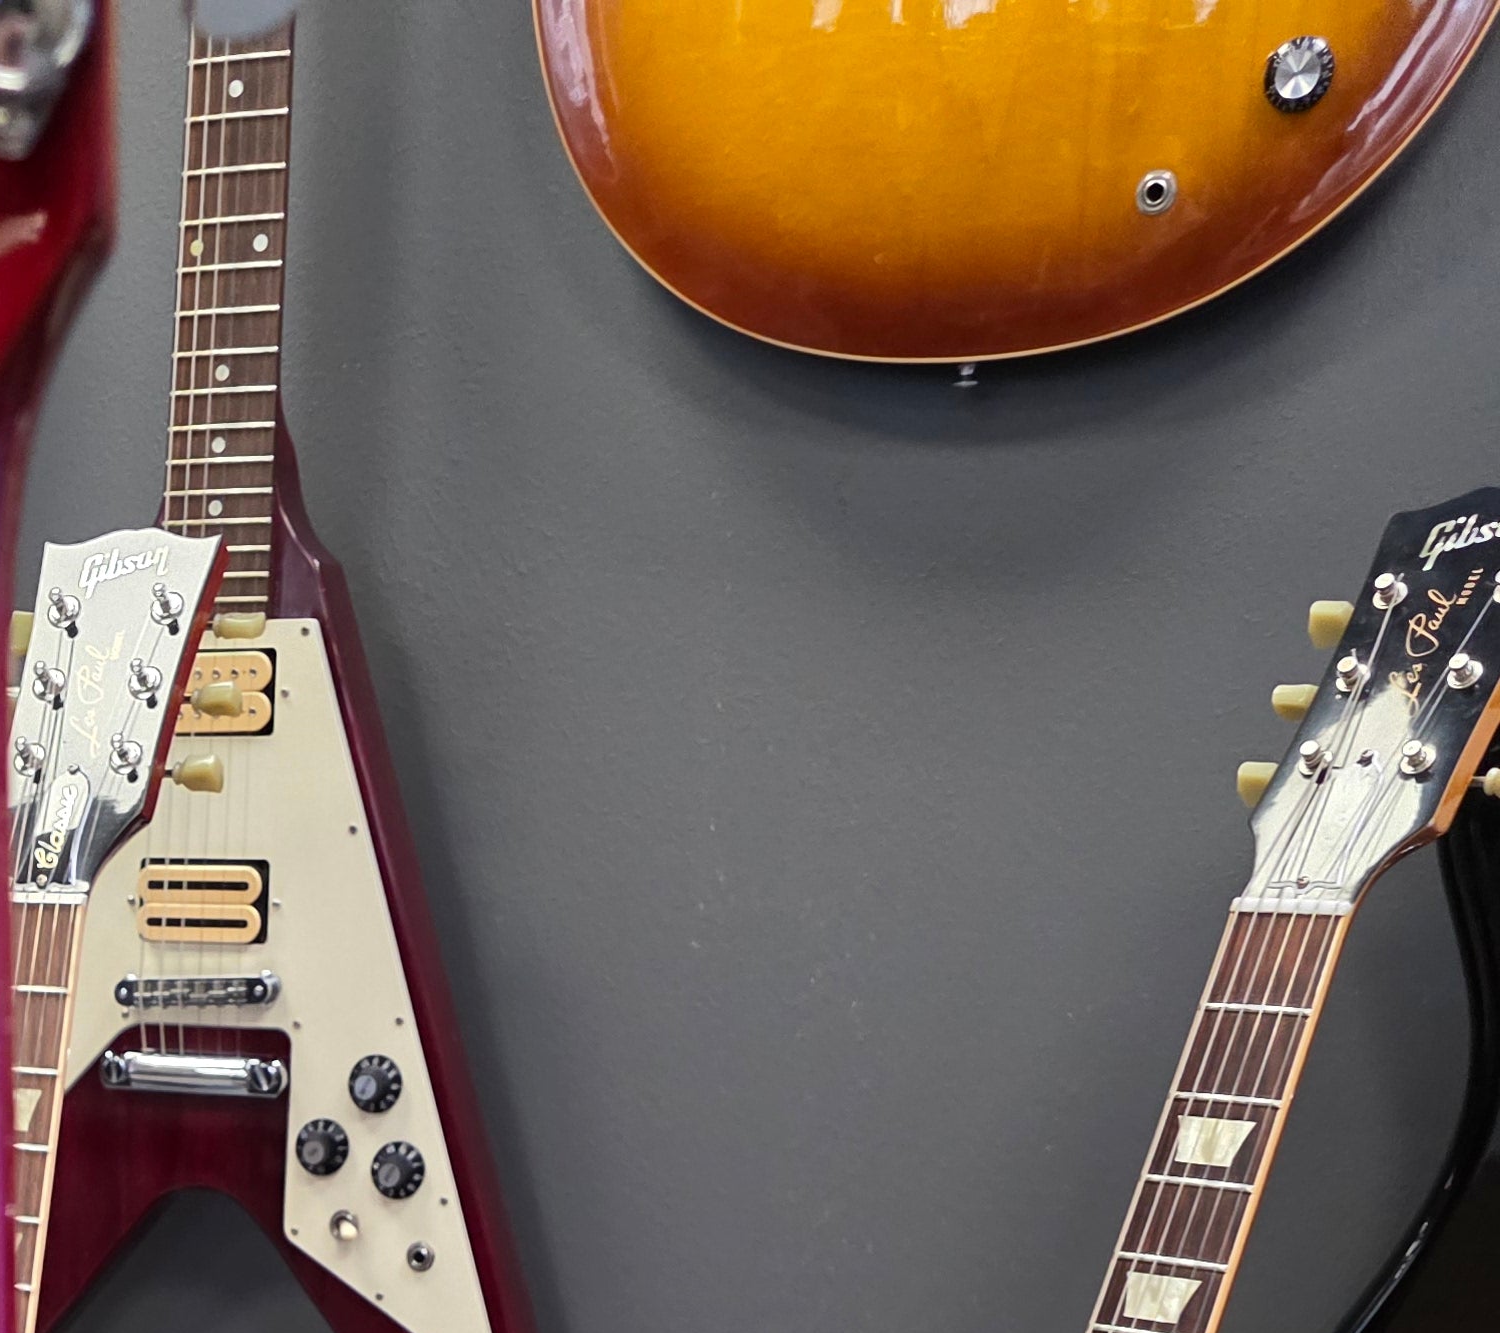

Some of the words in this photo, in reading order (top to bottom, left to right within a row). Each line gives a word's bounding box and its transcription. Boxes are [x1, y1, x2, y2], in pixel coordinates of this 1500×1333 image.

[78, 544, 169, 600] Gibson
[1418, 513, 1500, 571] Gibs
[1405, 588, 1457, 658] Paul
[77, 641, 114, 703] Paul
[1388, 662, 1424, 719] Les
[34, 783, 79, 869] Classic
